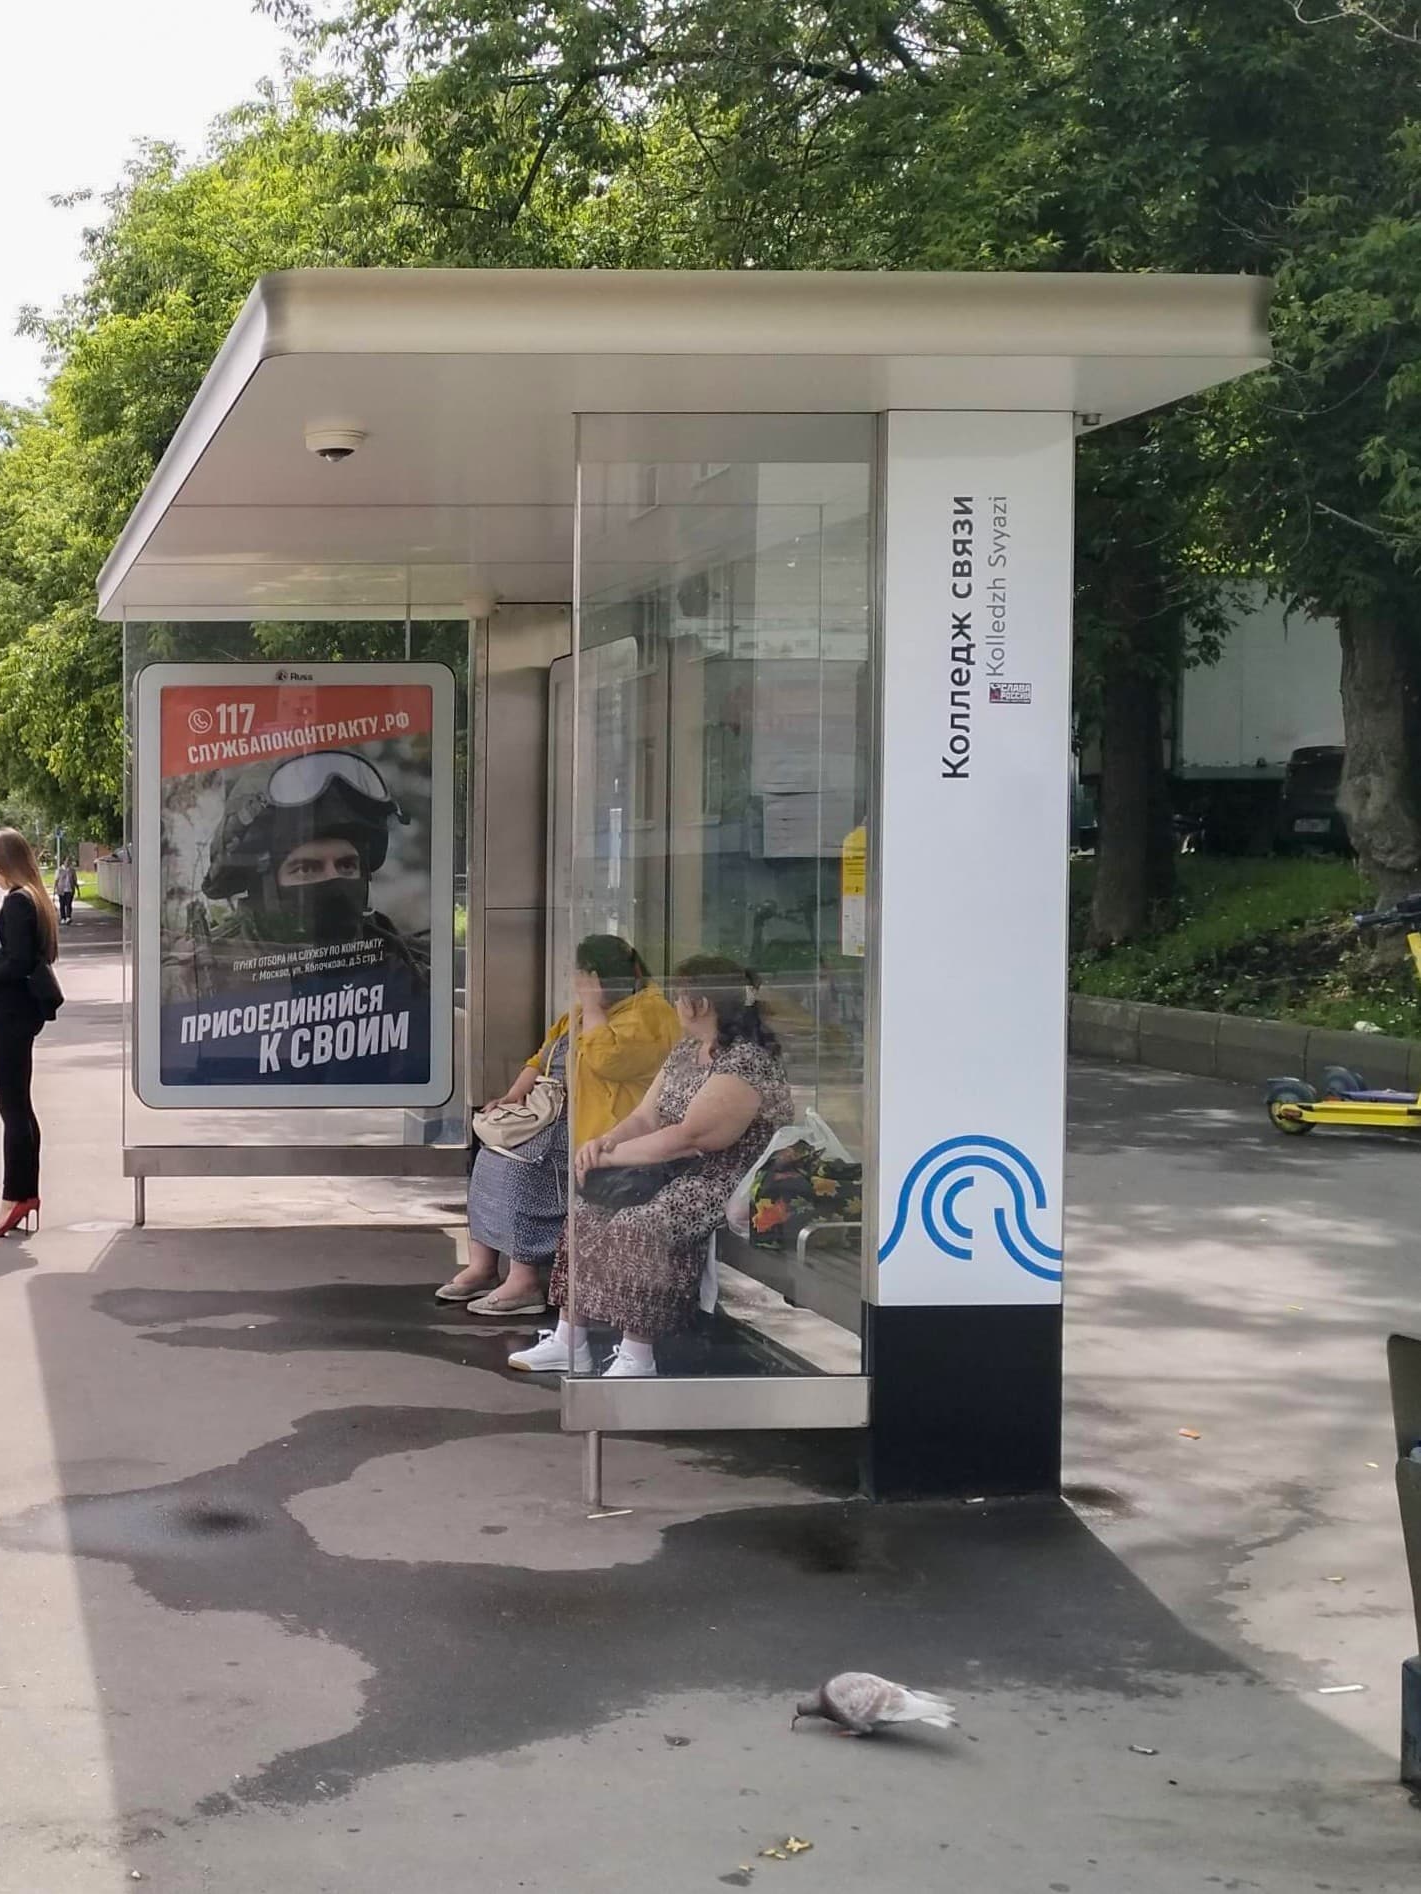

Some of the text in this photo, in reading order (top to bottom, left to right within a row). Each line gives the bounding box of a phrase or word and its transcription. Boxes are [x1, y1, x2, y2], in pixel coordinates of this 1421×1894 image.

[986, 496, 1011, 677] Kolledzh Svyazi
[941, 496, 976, 778] Колледж связи
[187, 711, 410, 764] СЛУЖБАПОКОНТРАКТУ.РФ
[216, 703, 256, 735] 117
[233, 958, 258, 972] ПУНКТ
[258, 953, 286, 967] ОТБОРА
[287, 951, 298, 963] НА
[298, 945, 329, 962] СЛУЖБУ
[330, 944, 340, 956] ПО
[181, 983, 384, 1044] ПРИСОЕДИНЯЙСЯ
[259, 1010, 410, 1074] К СВОИМ
